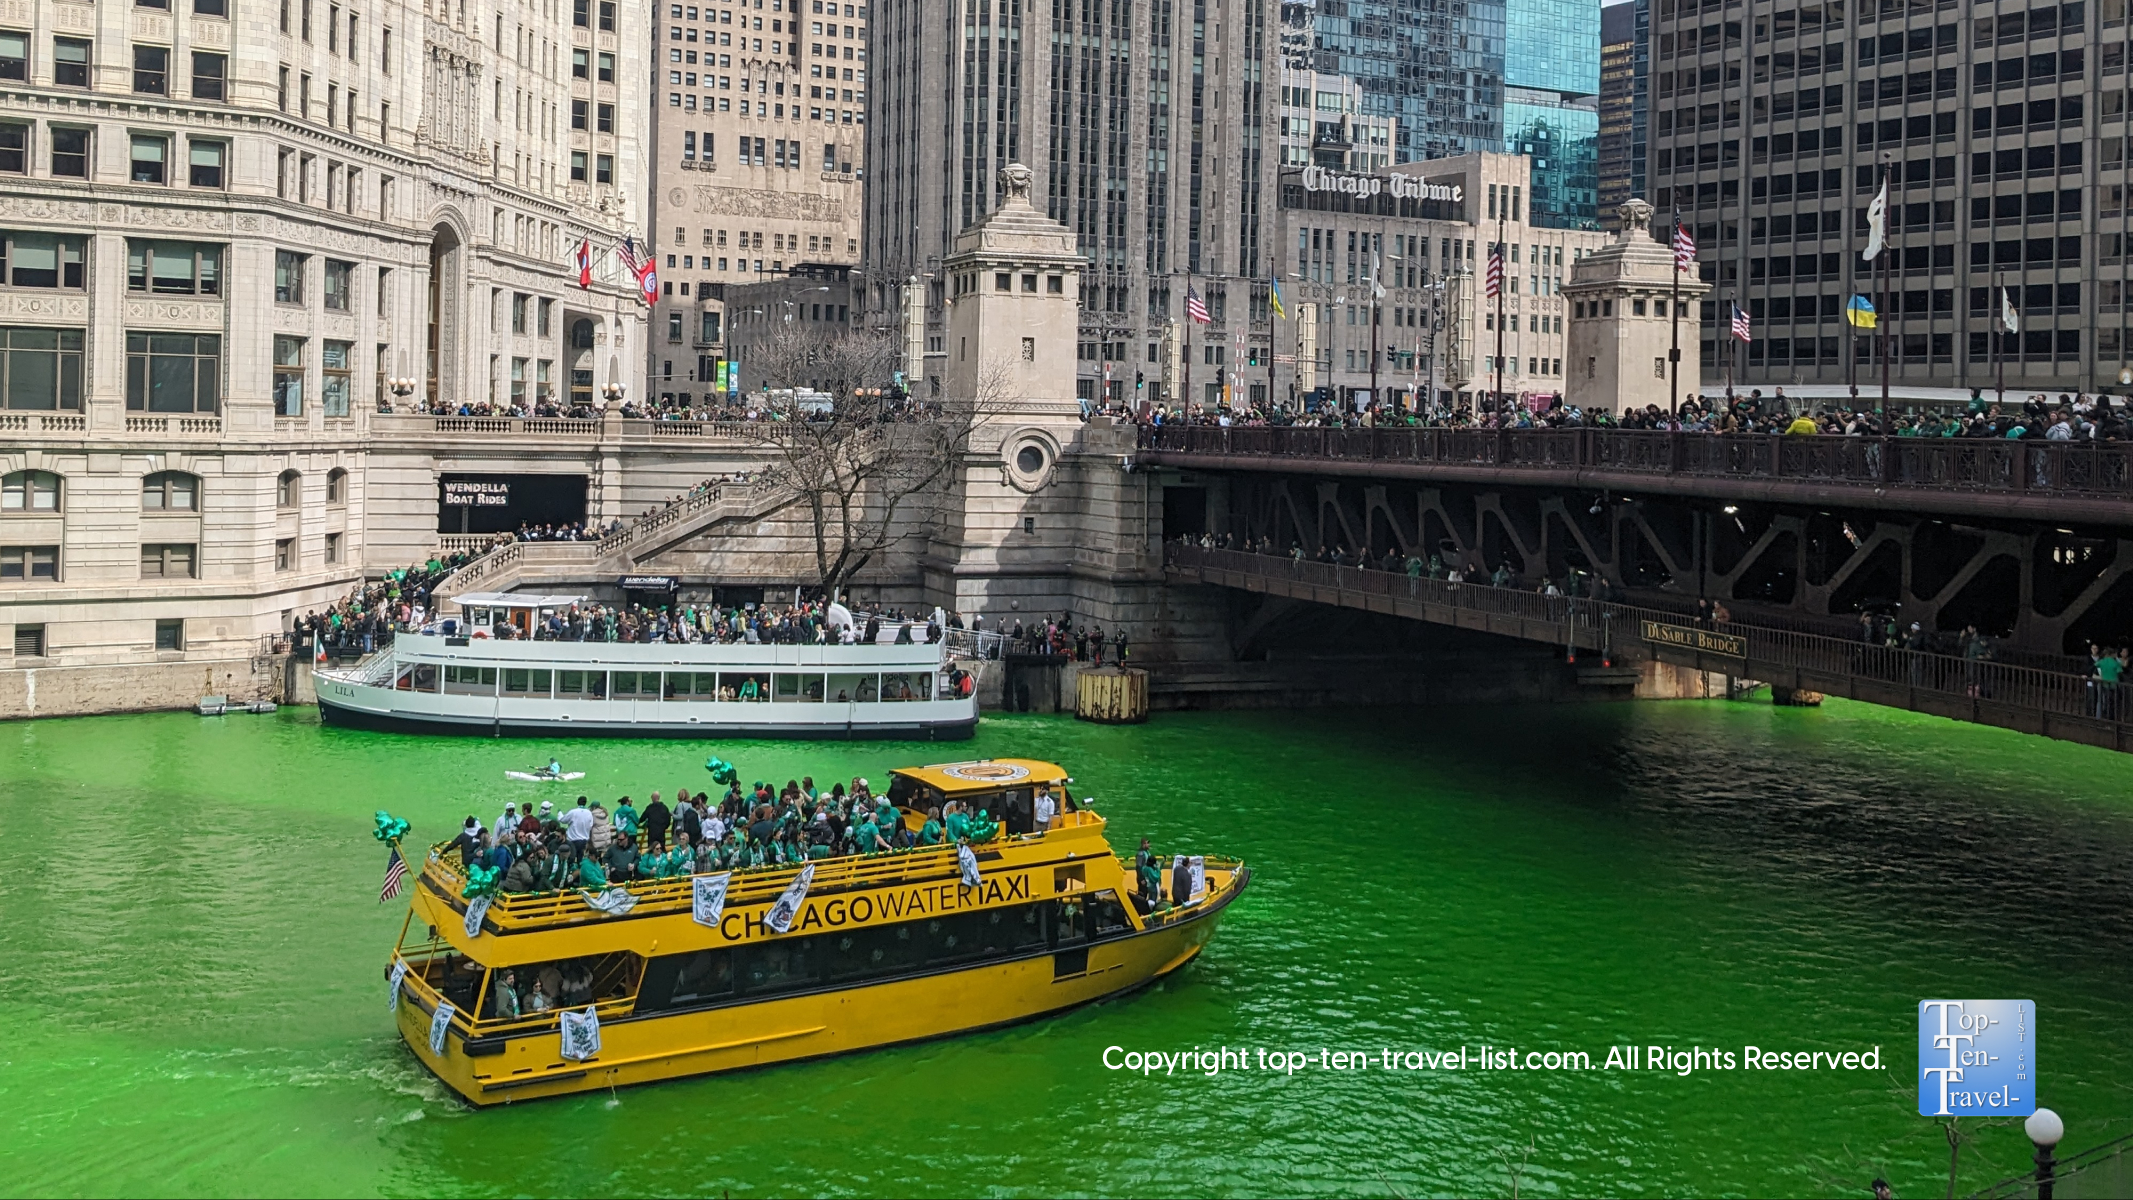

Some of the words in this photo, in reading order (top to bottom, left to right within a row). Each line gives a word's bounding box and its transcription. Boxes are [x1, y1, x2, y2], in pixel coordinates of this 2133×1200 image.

[1302, 165, 1381, 199] Chicago
[1390, 172, 1463, 202] Tribune
[445, 483, 508, 493] WENDELLA
[446, 493, 473, 504] BOAT
[477, 493, 506, 504] RIDES
[1698, 632, 1740, 654] BRIDGE
[335, 685, 355, 698] LILA
